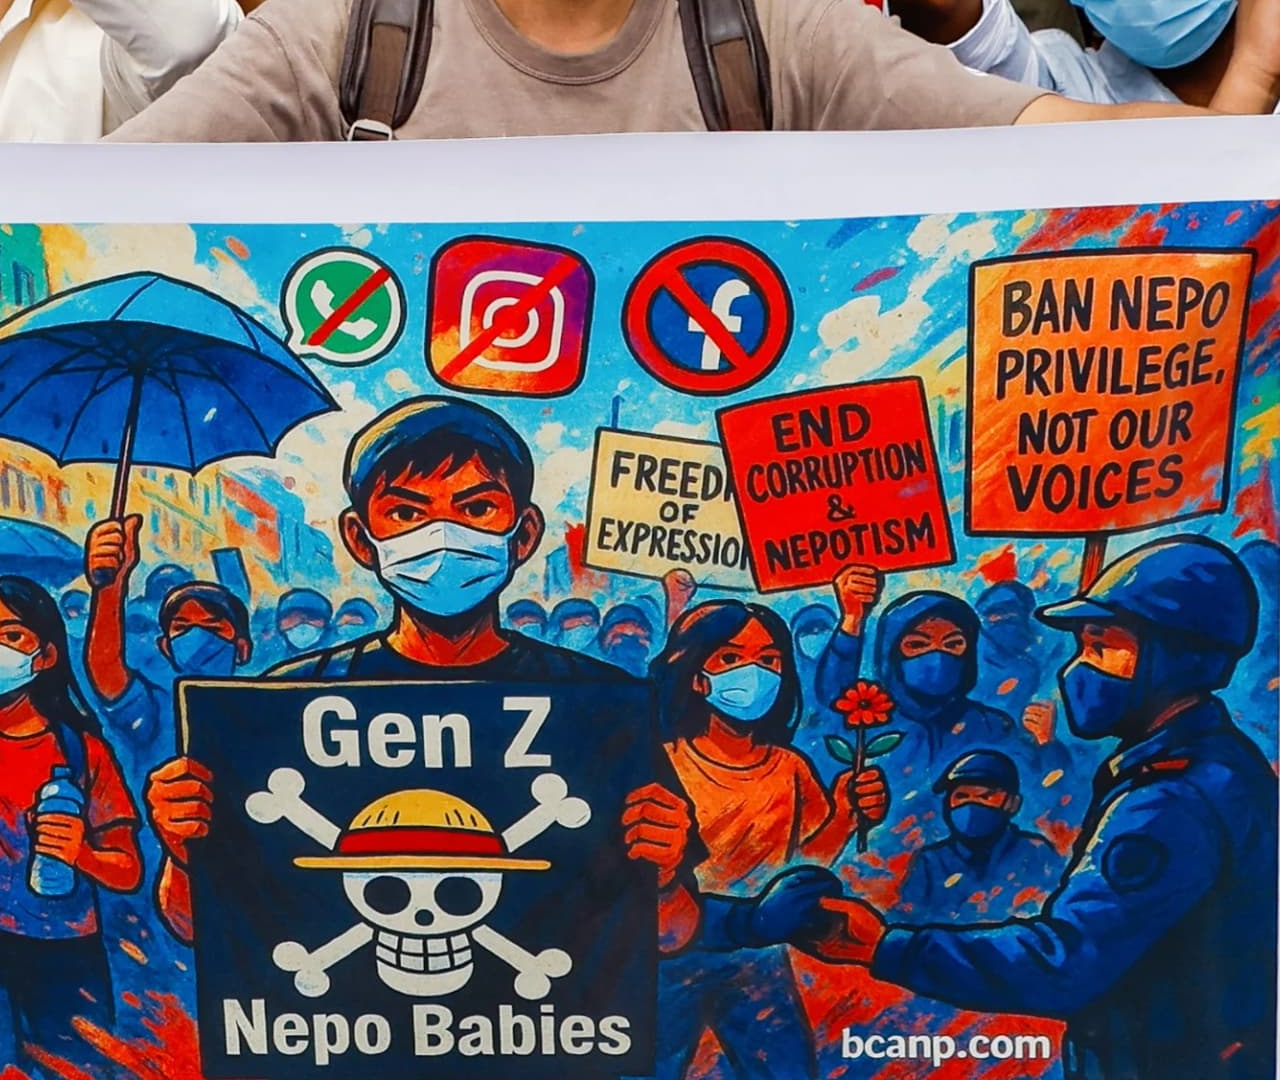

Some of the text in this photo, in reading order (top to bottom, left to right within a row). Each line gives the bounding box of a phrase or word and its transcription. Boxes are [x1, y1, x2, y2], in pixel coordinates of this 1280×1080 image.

[1002, 276, 1230, 337] BAN NEPO
[996, 338, 1225, 400] PRIVILEGE,
[772, 404, 870, 452] END
[1018, 400, 1193, 455] NOT OUR
[747, 439, 926, 503] CORRUPTION
[1007, 454, 1183, 514] VOICES
[659, 501, 699, 524] OF
[827, 494, 856, 521] &
[764, 512, 936, 573] NEPOTISM
[303, 695, 552, 768] Gen Z
[223, 998, 631, 1065] Nepo Babies
[842, 1027, 1051, 1067] bcanp.com
